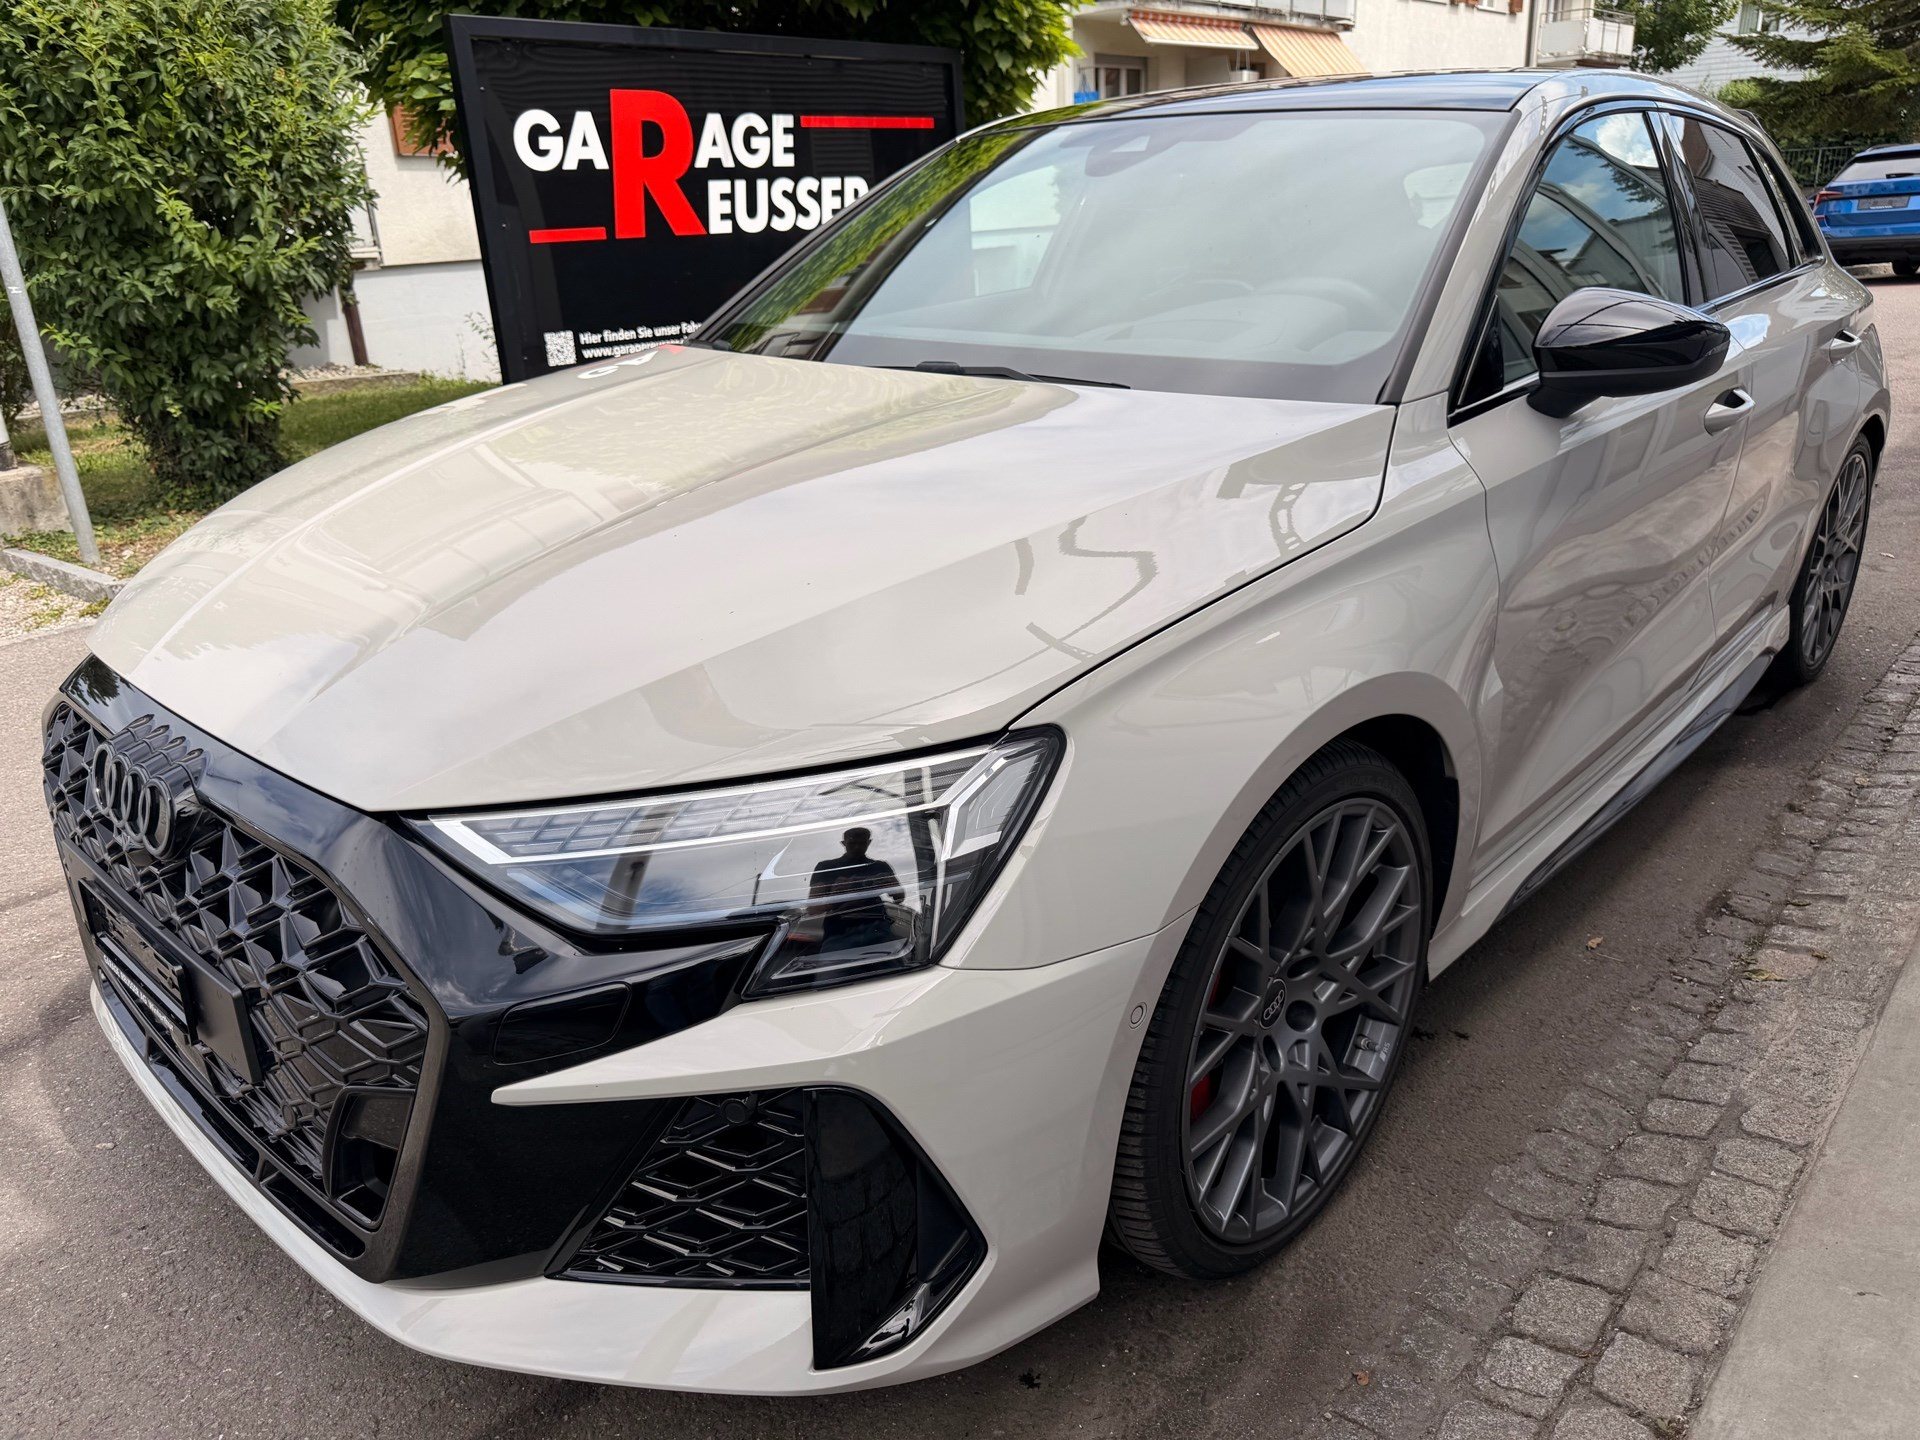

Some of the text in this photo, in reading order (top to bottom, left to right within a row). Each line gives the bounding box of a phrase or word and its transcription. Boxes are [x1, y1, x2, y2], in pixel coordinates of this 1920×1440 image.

[513, 88, 795, 239] GARAGE
[579, 331, 602, 345] Hier
[603, 328, 636, 342] finden
[637, 325, 653, 338] Sie
[653, 324, 680, 336] unser
